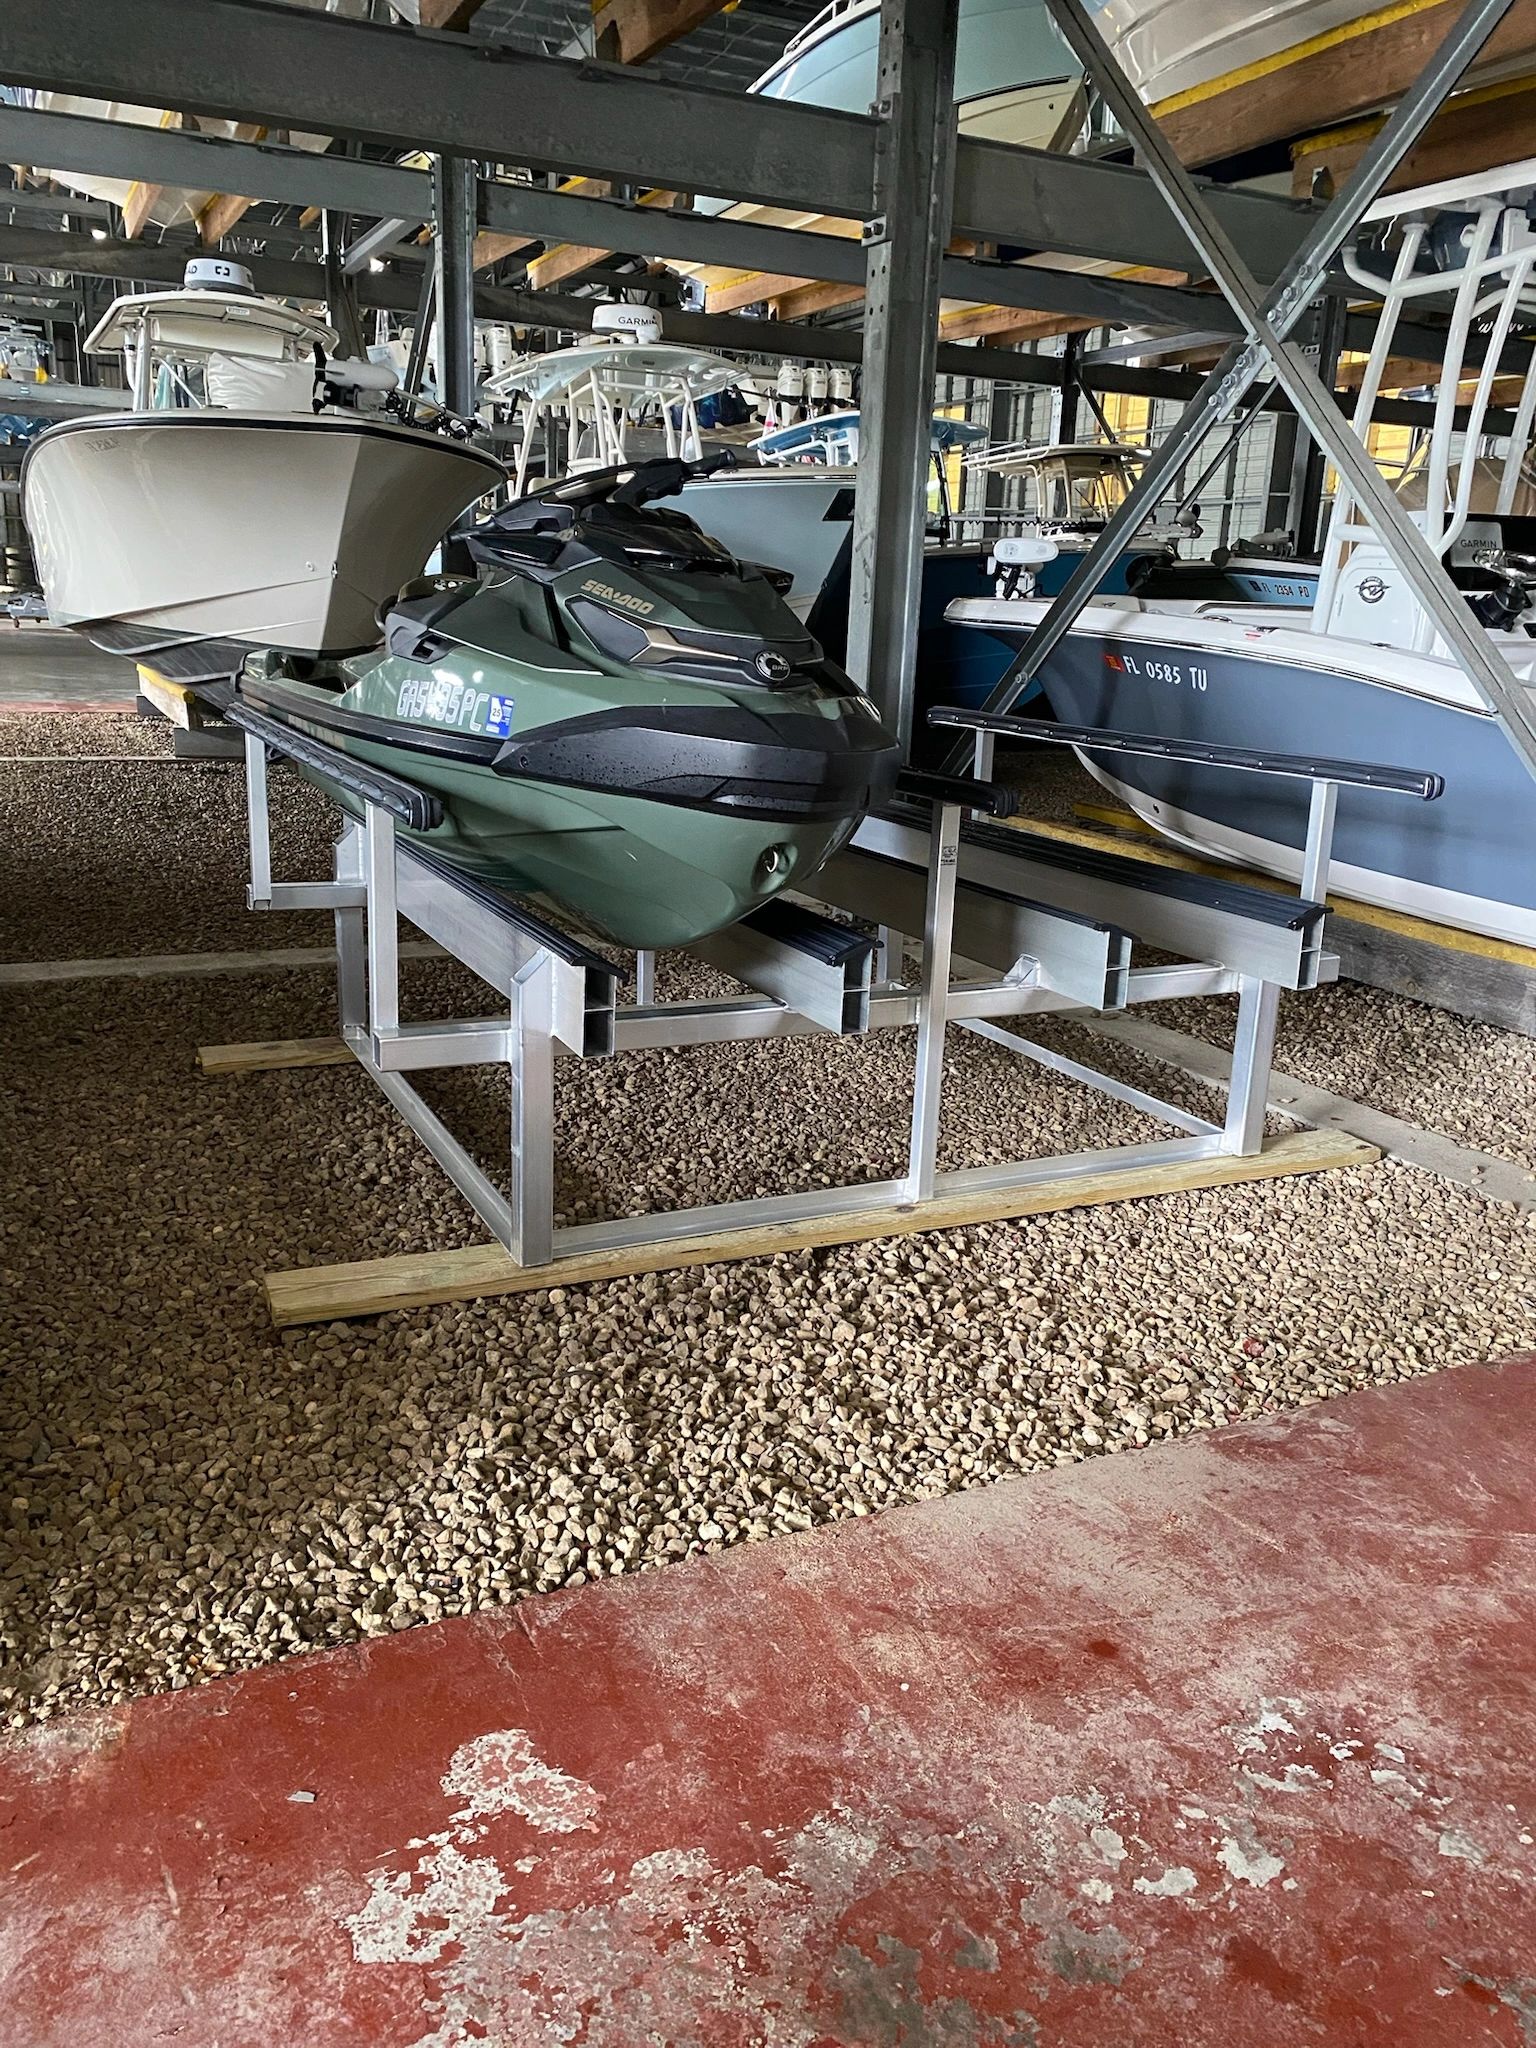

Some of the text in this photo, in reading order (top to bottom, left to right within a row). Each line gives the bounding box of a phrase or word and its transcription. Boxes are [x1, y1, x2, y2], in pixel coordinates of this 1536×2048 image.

[1460, 539, 1497, 549] GARMIN
[1260, 582, 1271, 593] FL
[1122, 655, 1141, 675] FL
[1145, 660, 1181, 685] 0585
[1189, 666, 1207, 692] TU
[491, 707, 501, 718] 25
